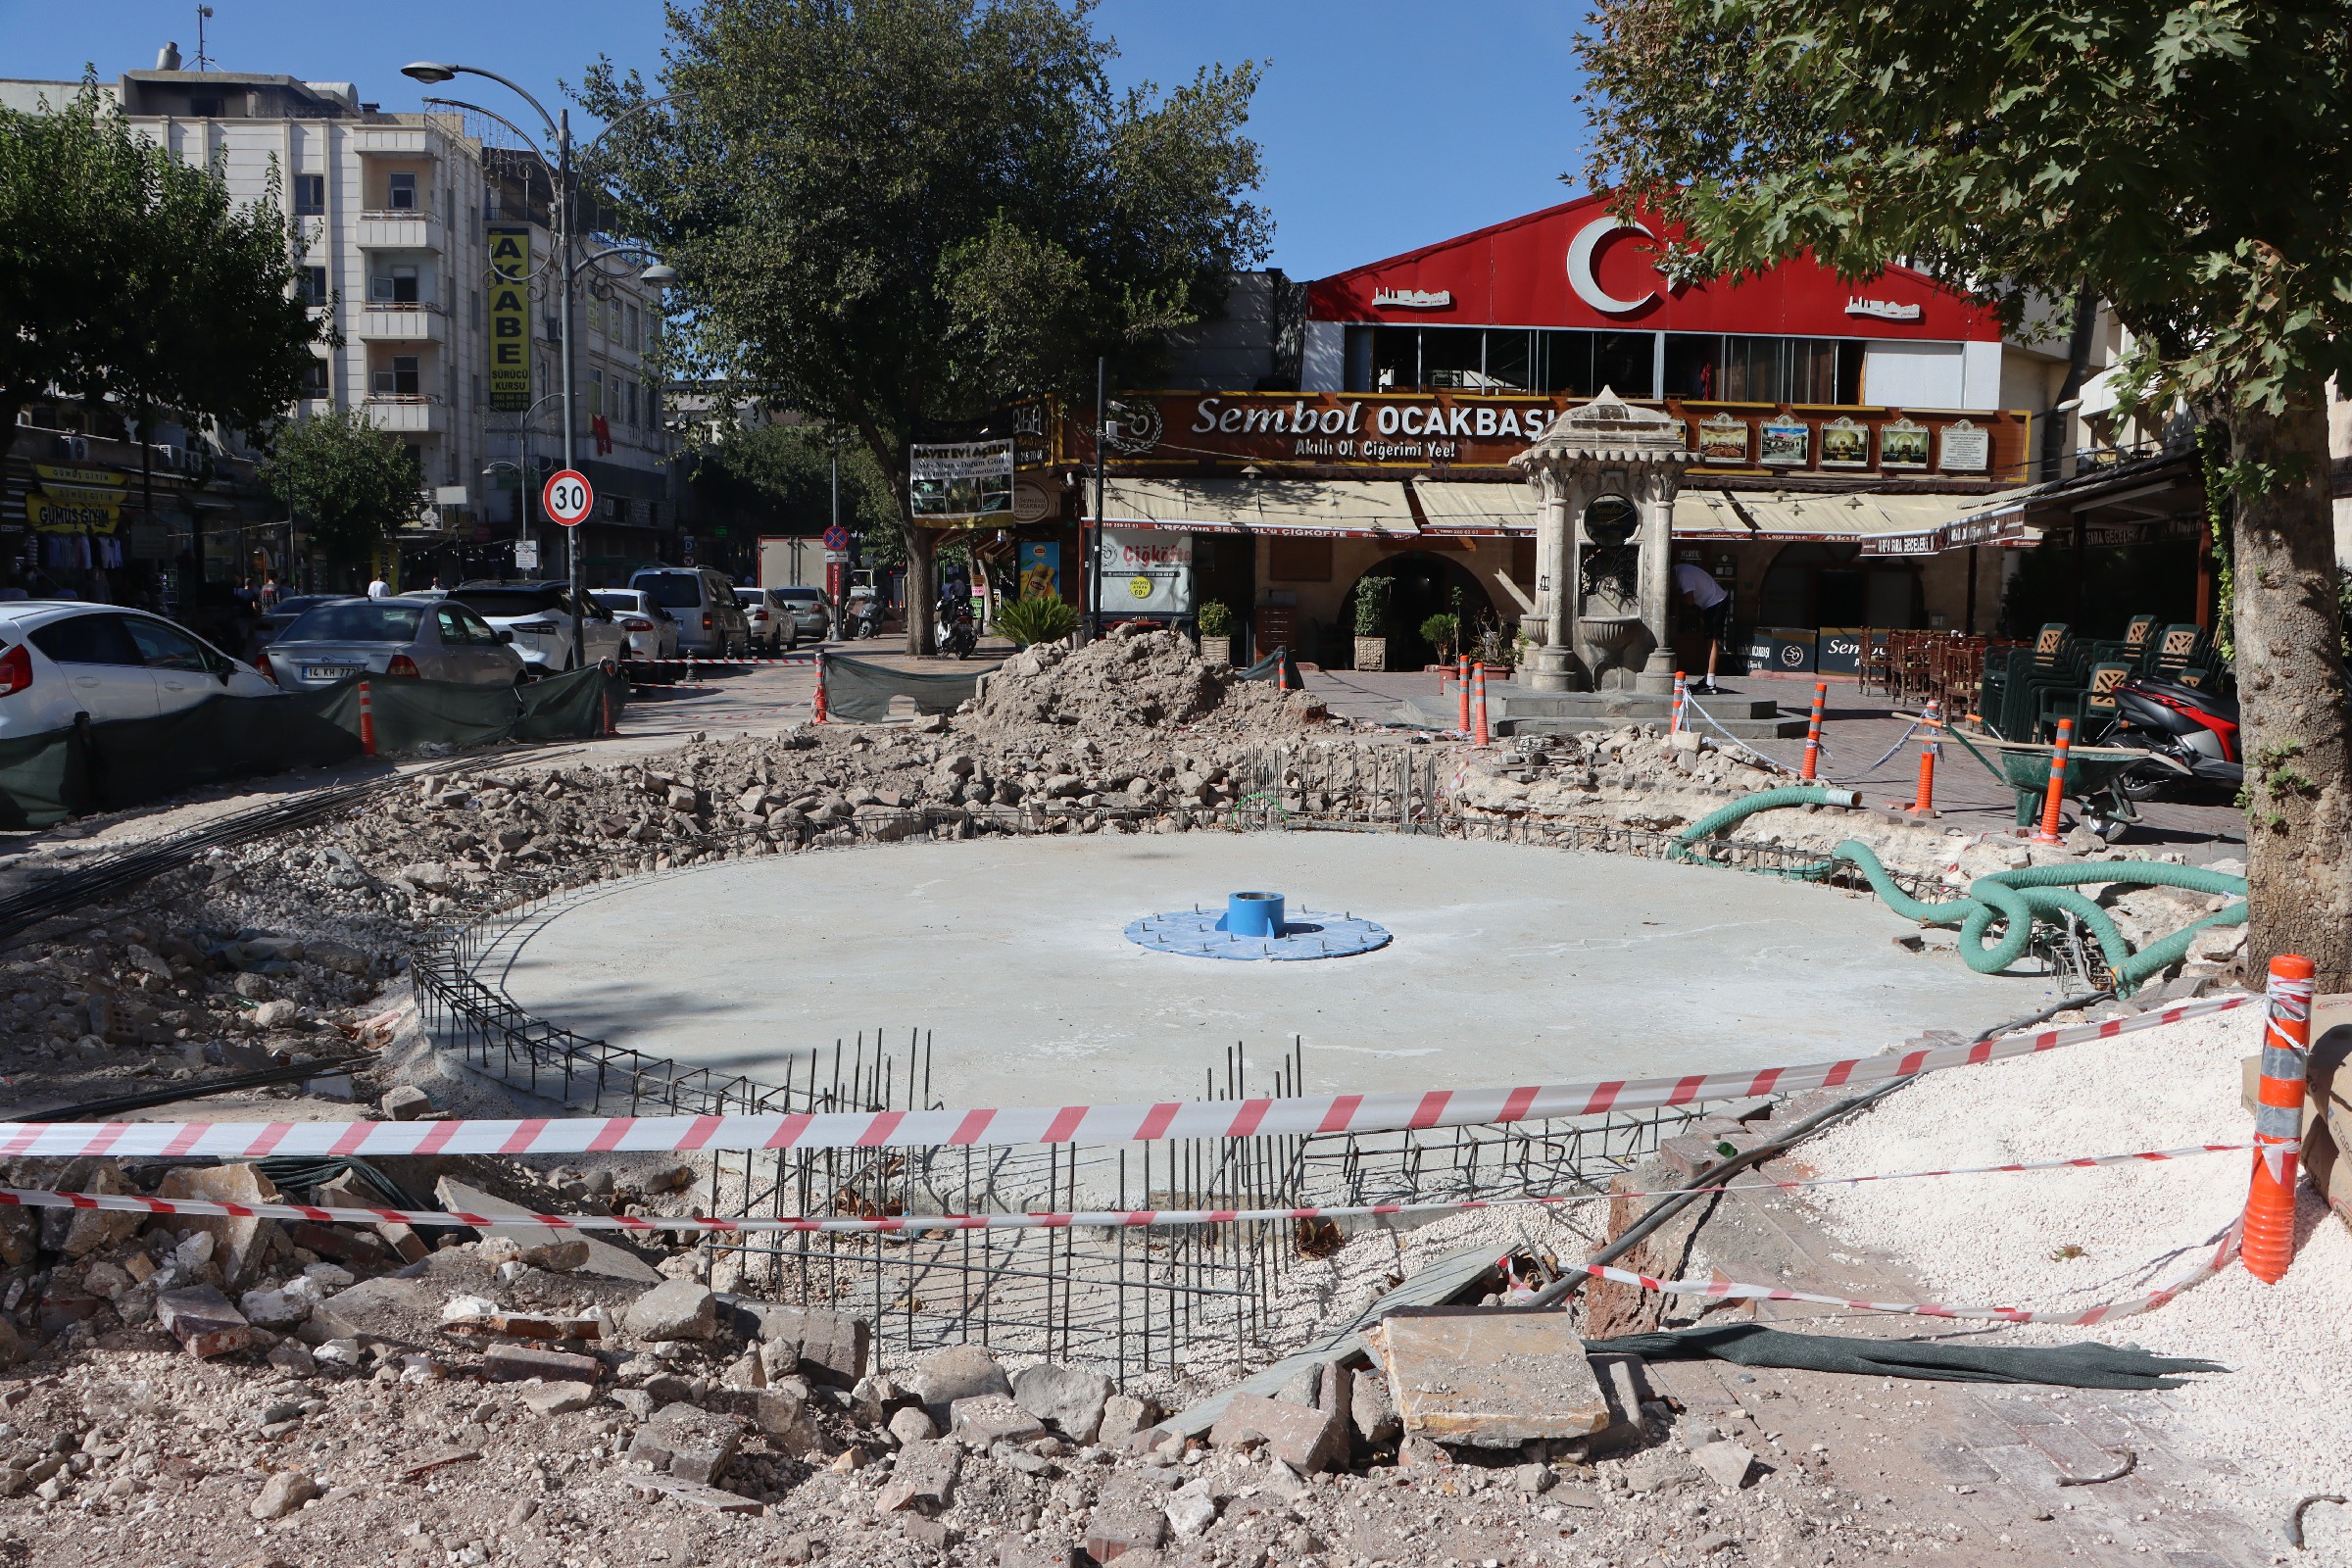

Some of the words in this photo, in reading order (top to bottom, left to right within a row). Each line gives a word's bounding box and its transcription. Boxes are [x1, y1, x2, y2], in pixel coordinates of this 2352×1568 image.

[493, 238, 522, 364] AKABE
[492, 368, 528, 379] SÜRÜCÜ
[495, 381, 526, 391] KURSU
[1191, 398, 1362, 434] Sembol
[1377, 405, 1555, 442] OCAKBAŞI
[913, 448, 950, 459] DAVET
[951, 445, 971, 459] EVİ
[972, 443, 1010, 459] AÇILDI
[1295, 439, 1334, 456] Akıllı
[1338, 441, 1356, 458] Ol,
[1363, 440, 1422, 460] Ciğerimi
[1427, 441, 1455, 458] Yee!
[53, 468, 82, 481] GÜMÜŞ
[85, 471, 111, 482] GİYİM
[555, 486, 584, 511] 30
[39, 503, 79, 529] GÜMÜŞ
[2085, 530, 2104, 546] SIRA
[1123, 544, 1192, 567] Çiğköfte
[309, 668, 318, 677] 14
[323, 668, 335, 677] KH
[2322, 1000, 2347, 1008] OYAK
